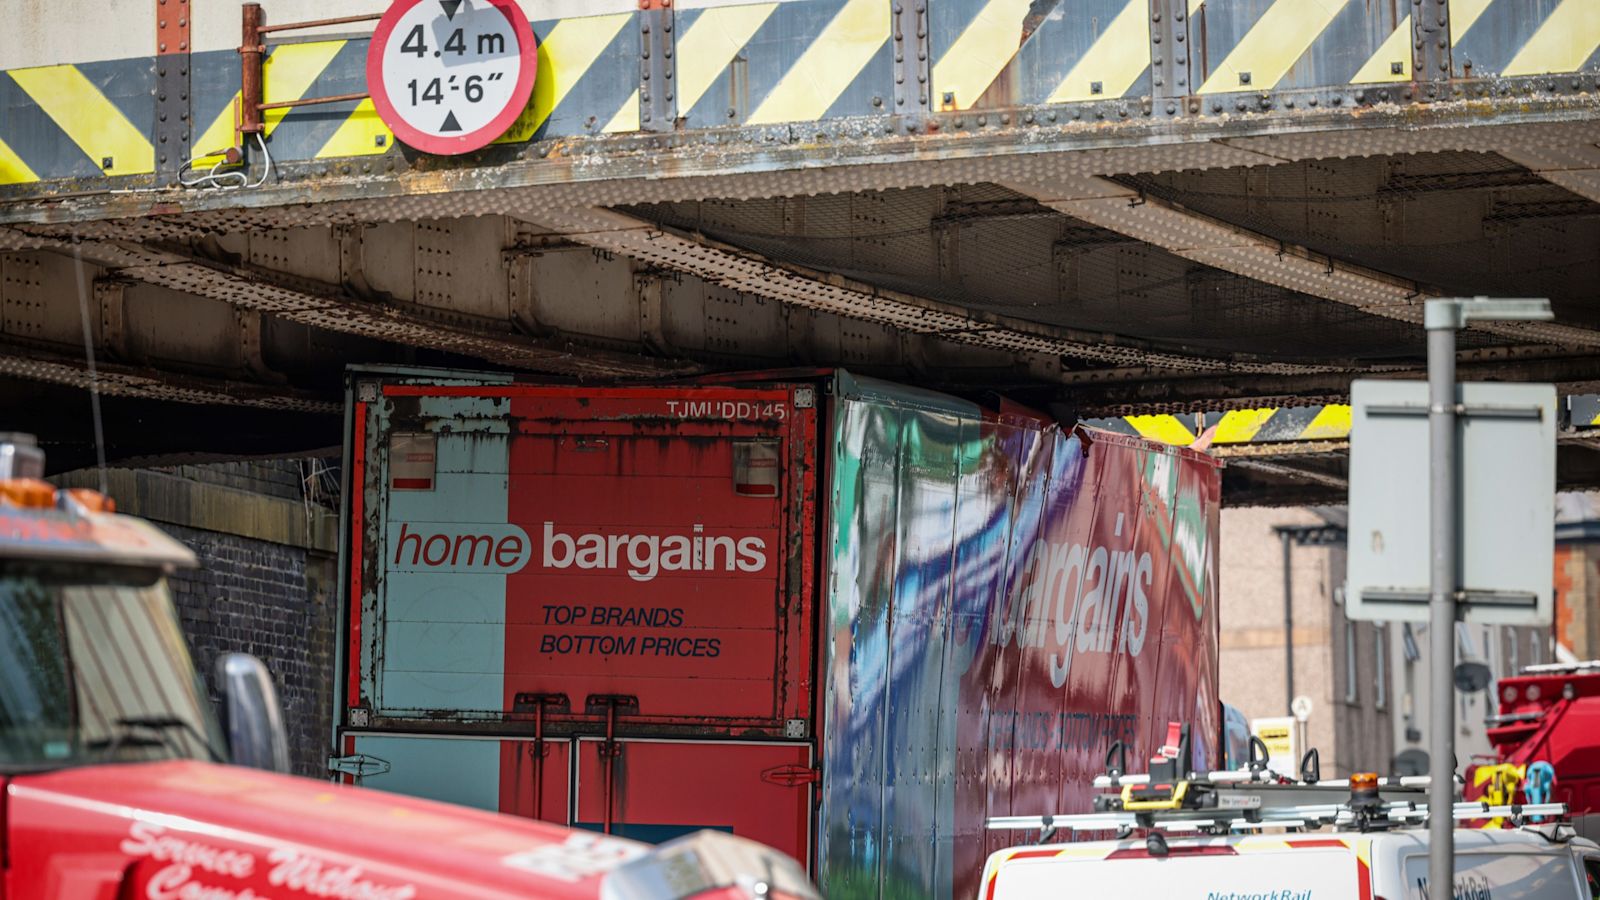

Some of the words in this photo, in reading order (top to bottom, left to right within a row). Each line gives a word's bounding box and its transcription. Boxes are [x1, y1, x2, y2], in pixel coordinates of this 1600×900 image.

[401, 24, 466, 58] 4.4
[477, 31, 505, 54] m
[394, 523, 523, 567] home
[542, 521, 767, 581] bargains
[542, 605, 586, 625] TOP
[591, 606, 684, 627] BRANDS
[539, 634, 636, 655] BOTTOM
[640, 637, 721, 657] PRICES
